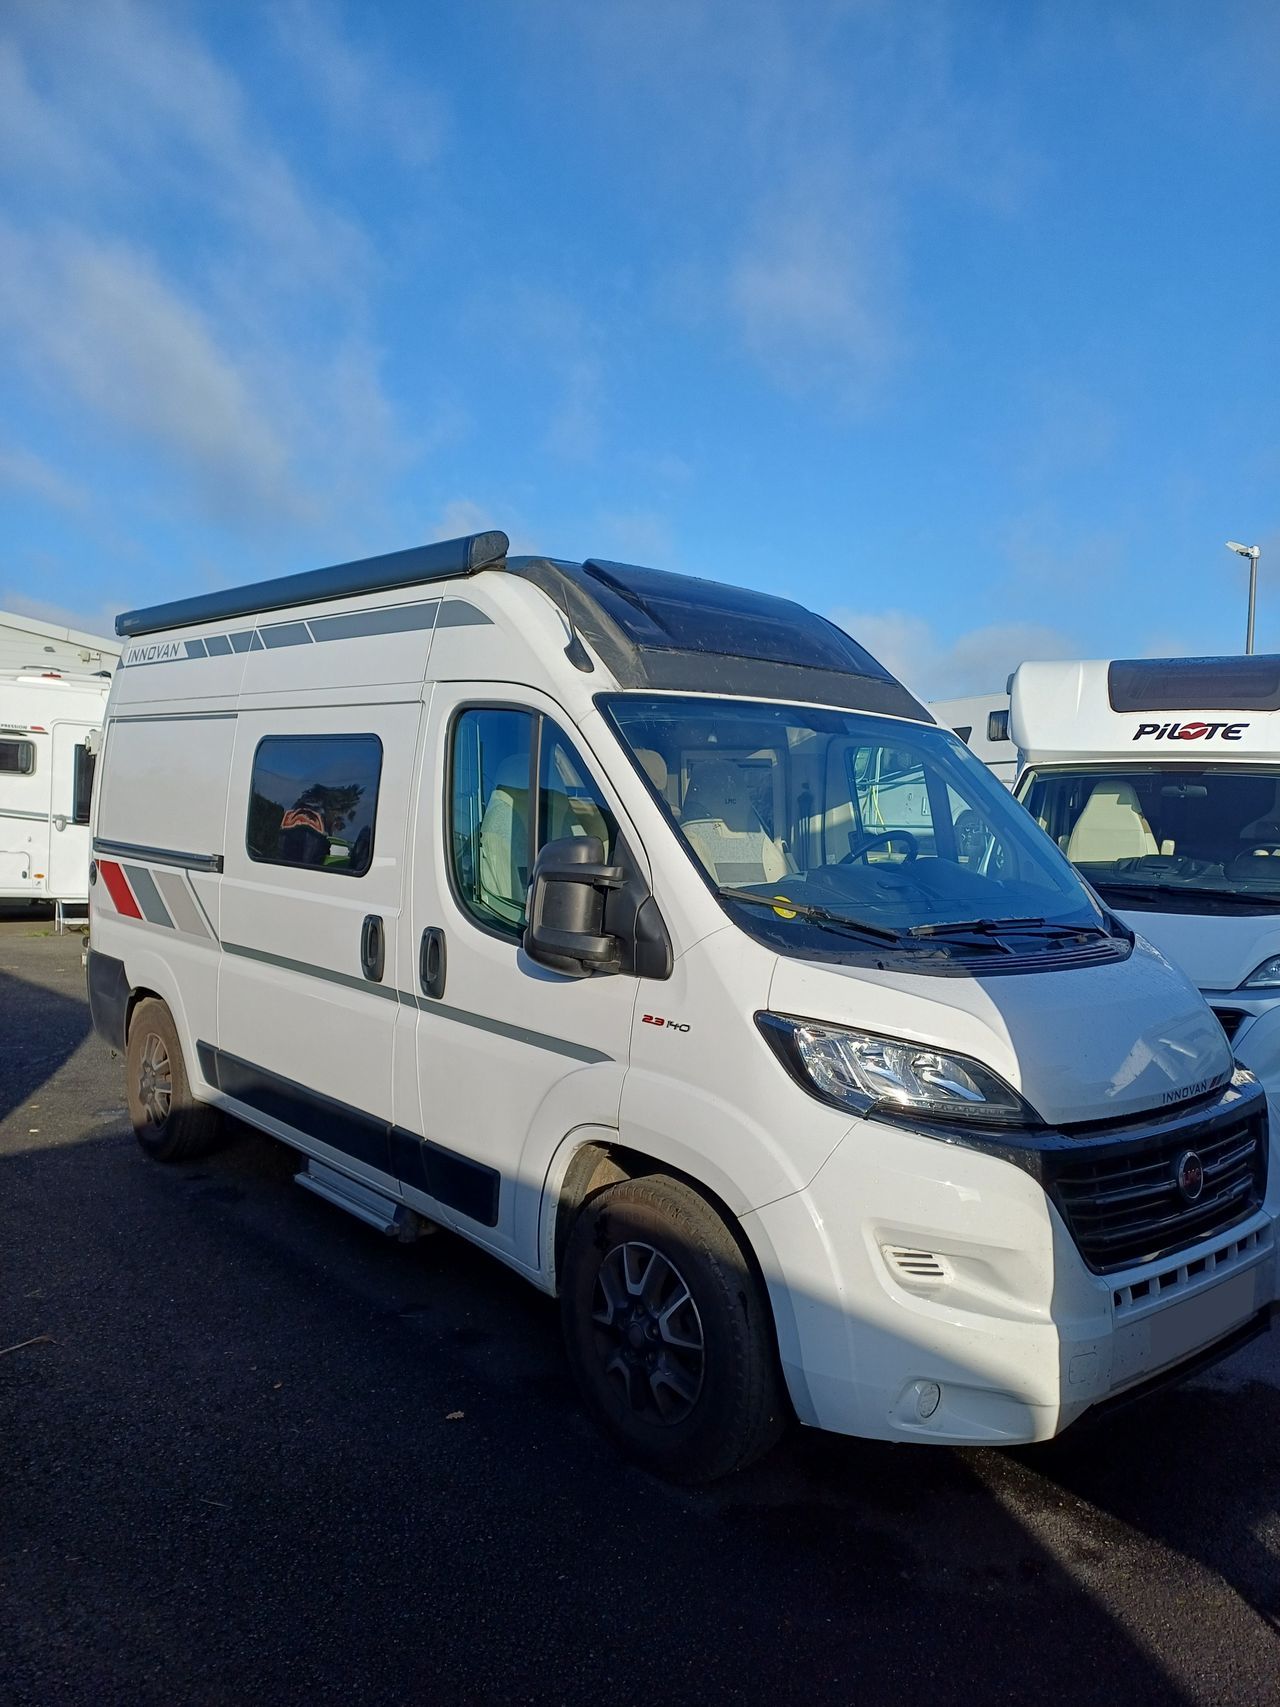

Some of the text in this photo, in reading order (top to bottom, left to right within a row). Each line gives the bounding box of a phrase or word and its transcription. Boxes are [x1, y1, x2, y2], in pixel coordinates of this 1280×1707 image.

[127, 642, 181, 663] INNOVAN
[666, 1020, 691, 1032] 140
[1162, 1080, 1208, 1104] INNOVAN
